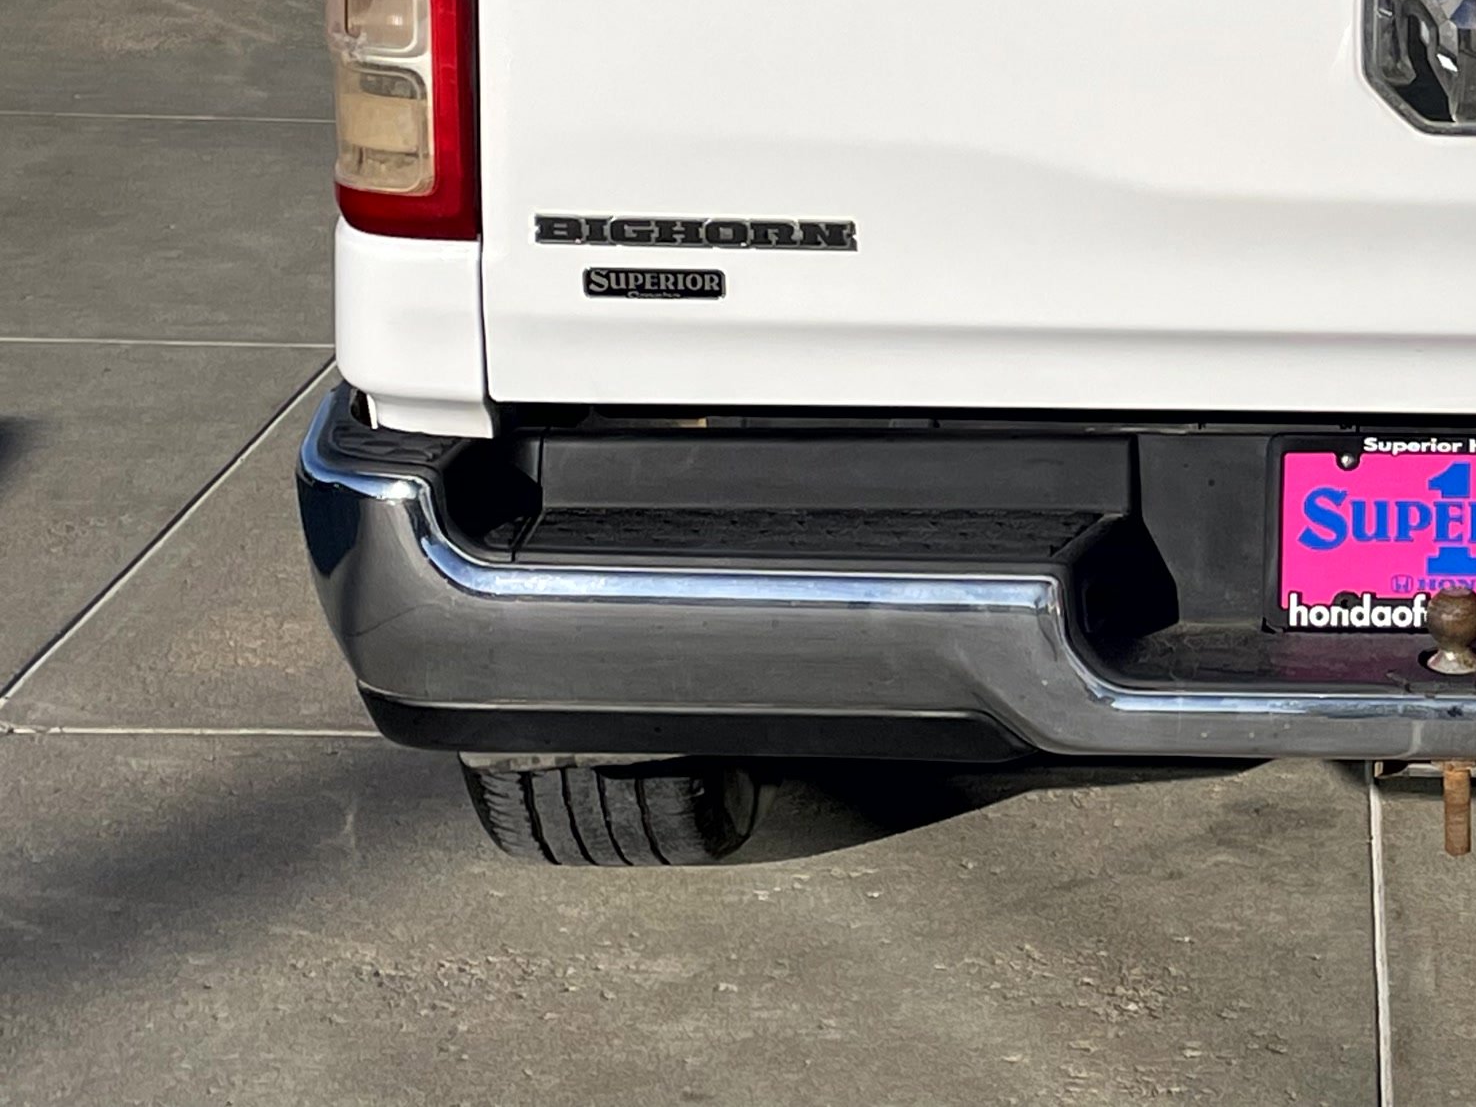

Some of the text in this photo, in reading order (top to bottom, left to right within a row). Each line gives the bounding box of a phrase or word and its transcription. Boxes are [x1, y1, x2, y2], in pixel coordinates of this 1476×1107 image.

[534, 215, 858, 251] BIGHORN
[588, 269, 721, 292] SUPERIOR
[1363, 437, 1463, 455] Superior
